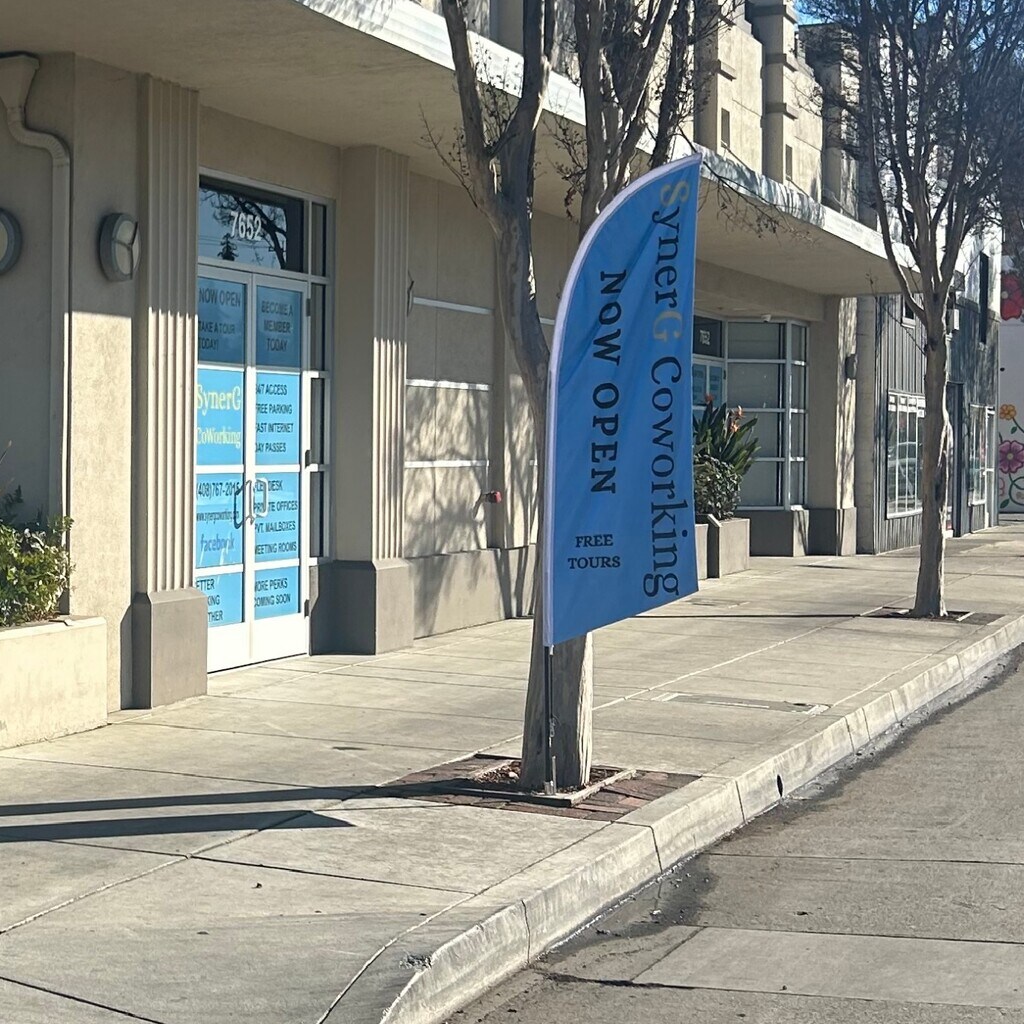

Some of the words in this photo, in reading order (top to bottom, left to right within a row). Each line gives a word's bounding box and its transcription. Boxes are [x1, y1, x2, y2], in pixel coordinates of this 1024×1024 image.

[230, 211, 263, 241] 7652
[652, 181, 690, 343] SynerG
[199, 288, 217, 304] NOW
[220, 290, 241, 308] OPEN
[261, 300, 288, 315] BECOME
[593, 270, 626, 366] NOW
[264, 320, 290, 334] MEMBER
[266, 338, 288, 352] TODAY
[266, 384, 288, 396] ACCESS
[196, 384, 241, 416] SynerG
[269, 404, 292, 414] PARKING
[256, 422, 267, 433] AST
[268, 422, 294, 433] INTERNET
[590, 382, 620, 494] OPEN
[265, 442, 286, 453] PASSES
[643, 356, 688, 597] Coworking
[276, 500, 298, 512] OFFICES
[266, 522, 296, 532] MAILBOXES
[278, 542, 297, 553] ROOMS
[575, 534, 614, 548] FREE
[568, 556, 621, 570] TOURS
[270, 578, 288, 589] PERKS
[276, 594, 291, 604] SOON
